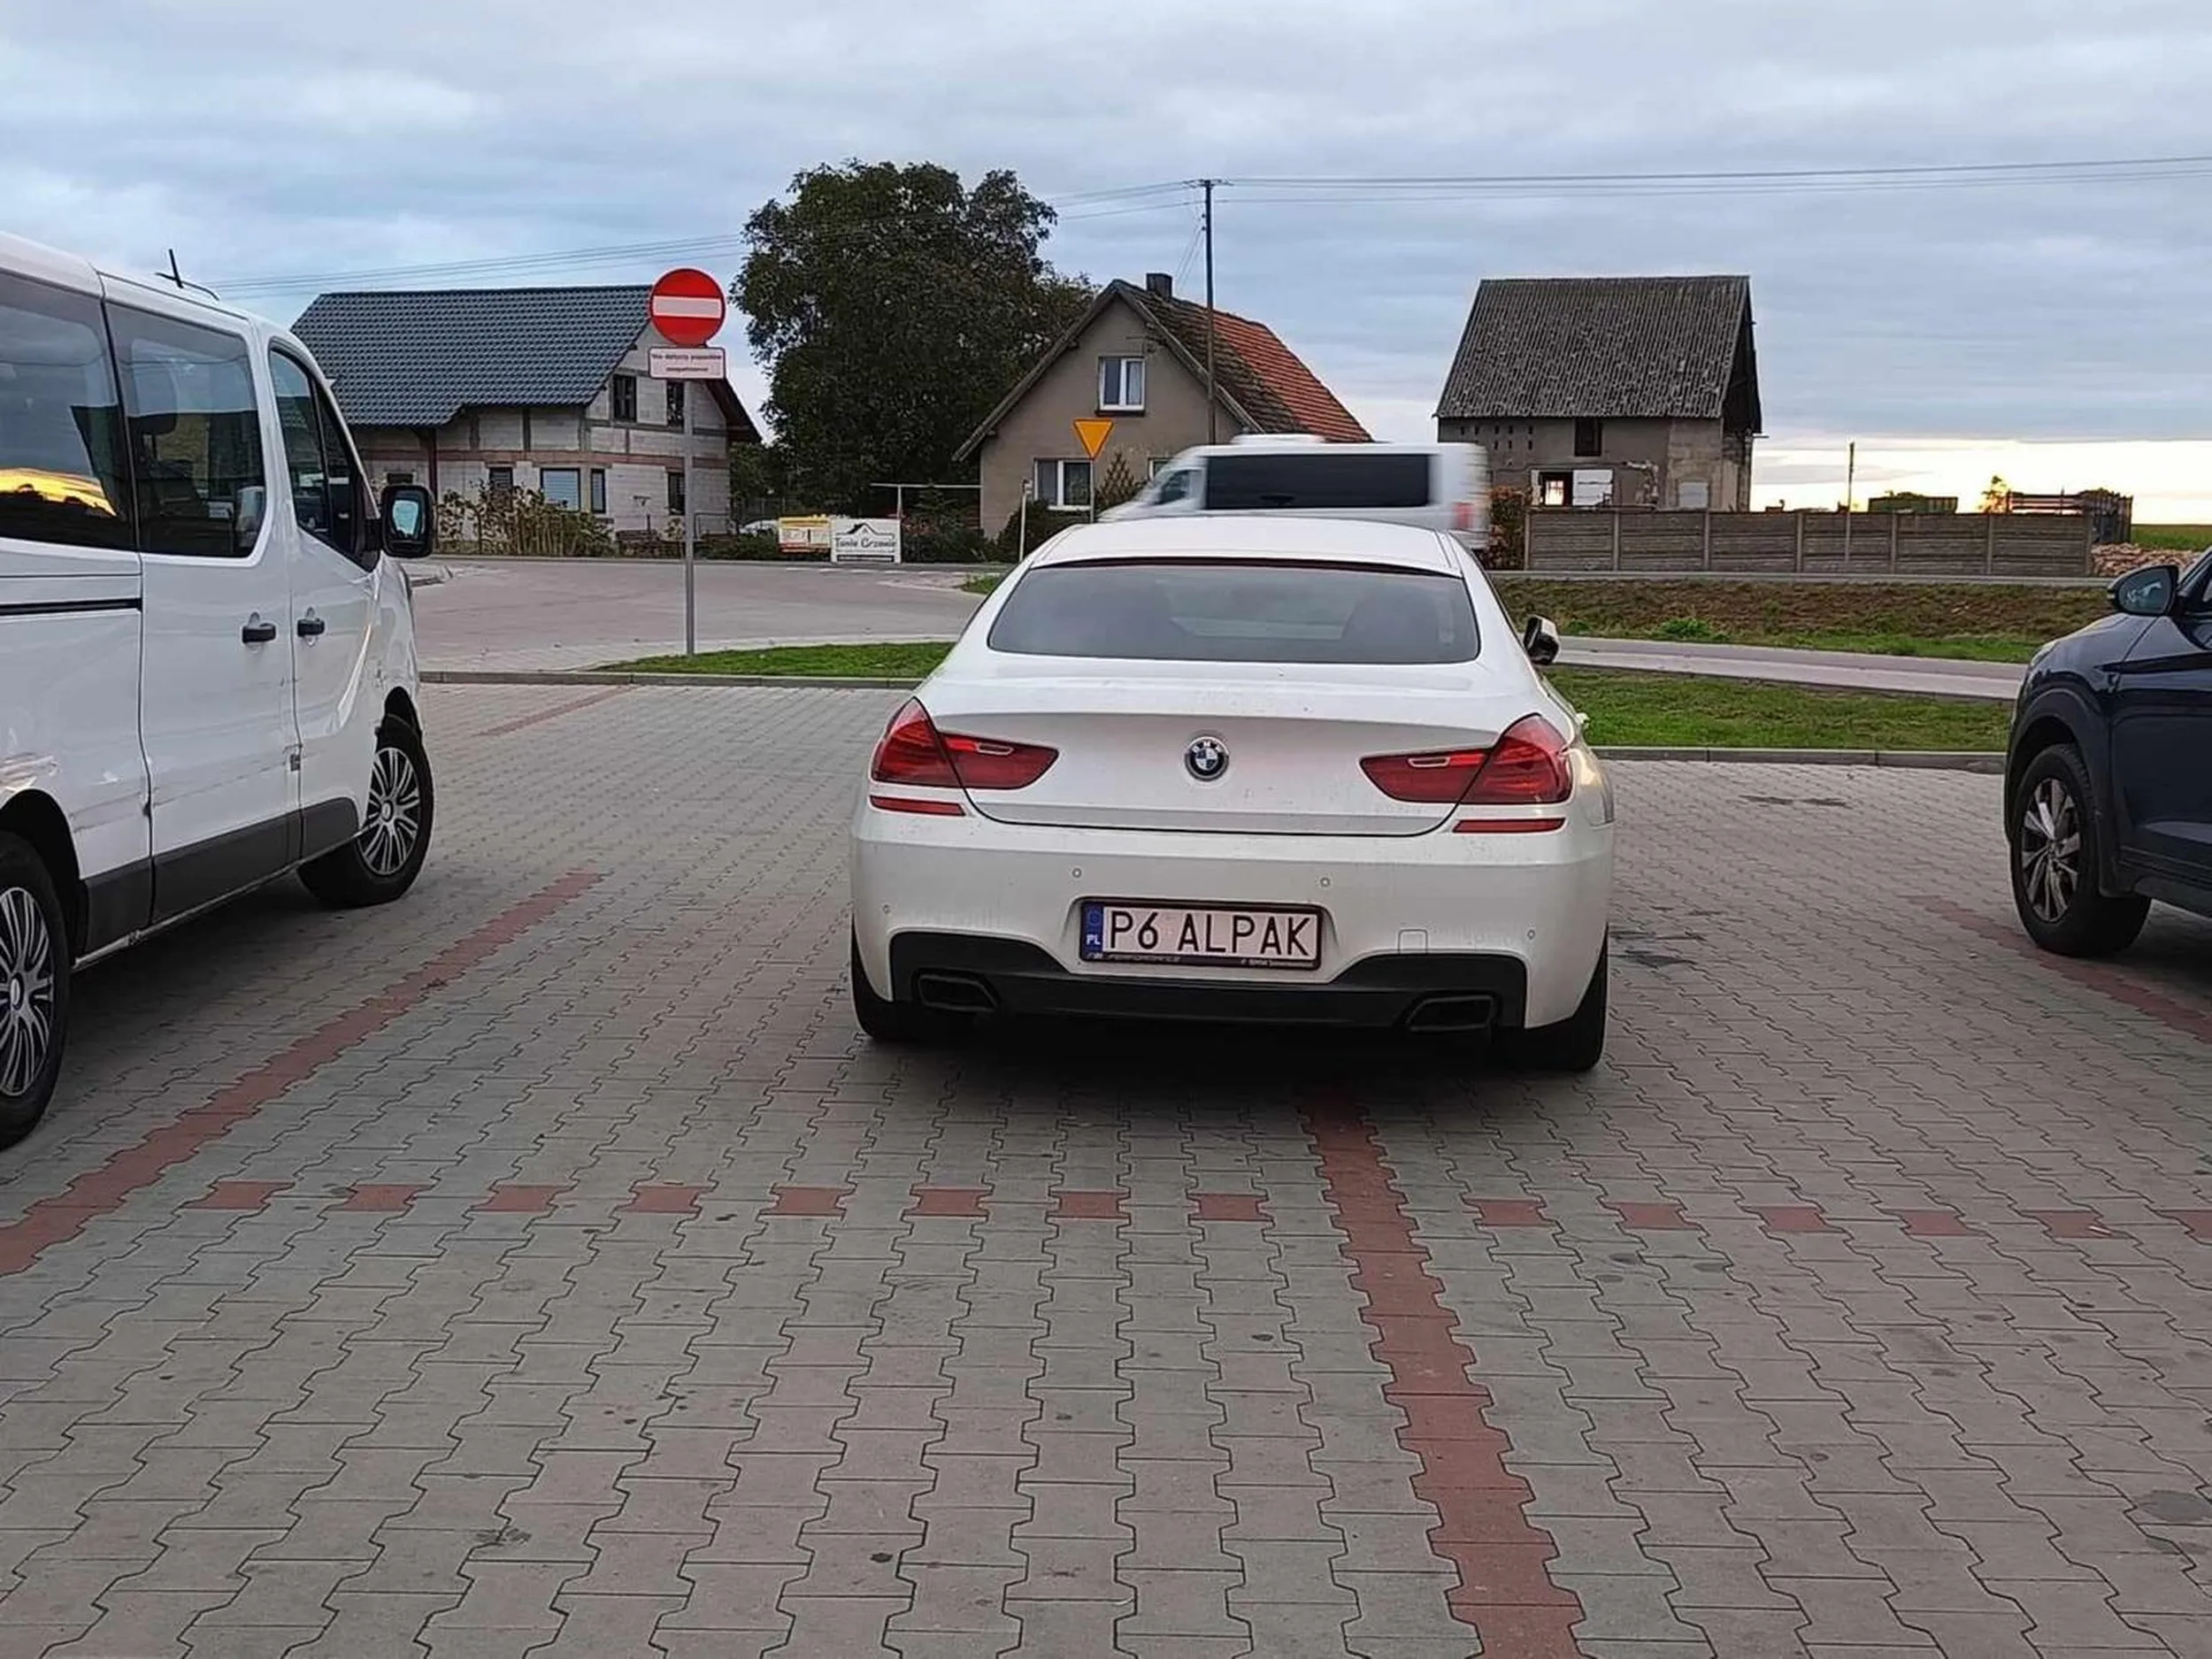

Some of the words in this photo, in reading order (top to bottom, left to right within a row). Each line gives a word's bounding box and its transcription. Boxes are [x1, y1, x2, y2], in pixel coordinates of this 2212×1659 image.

[1192, 741, 1223, 754] BMW
[1110, 910, 1159, 950] P6
[1178, 913, 1311, 956] ALPAK
[1087, 934, 1101, 946] PL
